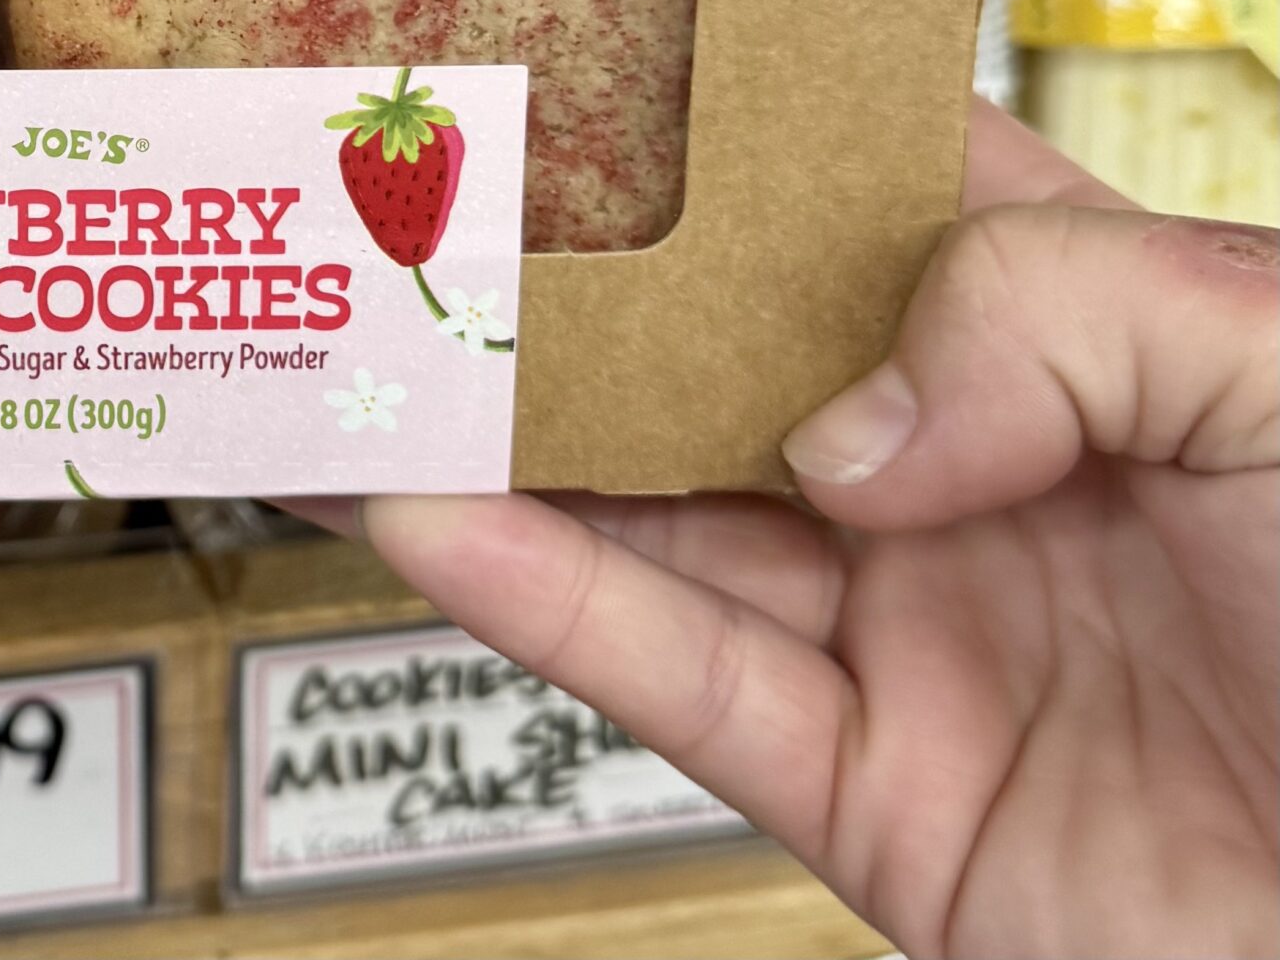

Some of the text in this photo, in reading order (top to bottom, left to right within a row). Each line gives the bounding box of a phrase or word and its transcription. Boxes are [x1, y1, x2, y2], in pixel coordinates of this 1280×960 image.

[72, 345, 91, 371] &
[96, 343, 234, 379] Strawberry
[238, 343, 330, 371] Powder
[23, 398, 62, 430] OZ
[67, 393, 167, 440] (300g)
[266, 720, 464, 798] MINI
[386, 758, 580, 826] CAKE
